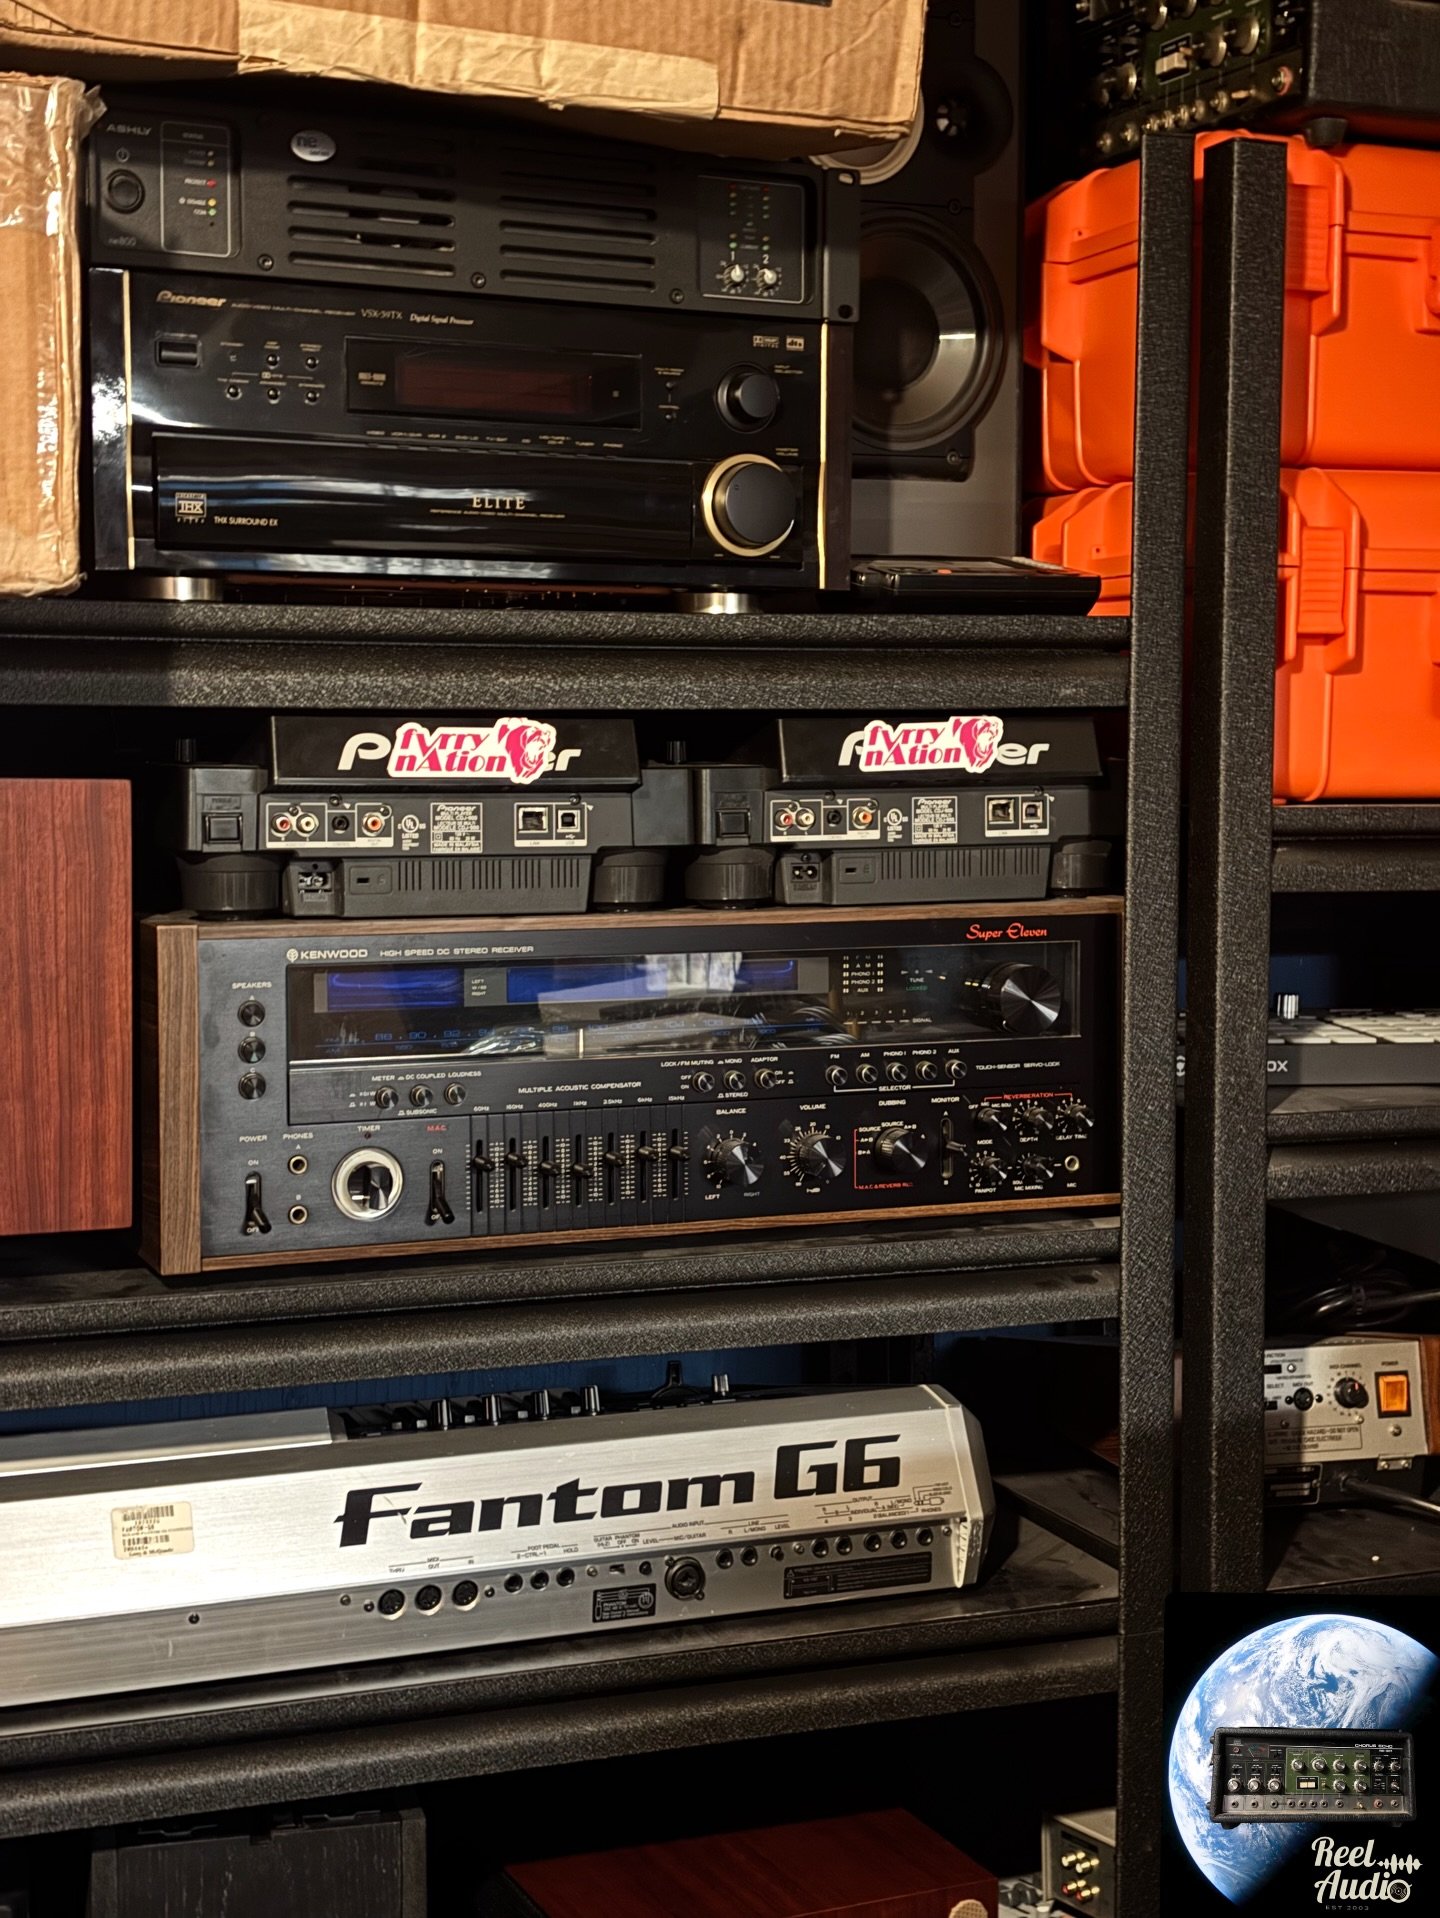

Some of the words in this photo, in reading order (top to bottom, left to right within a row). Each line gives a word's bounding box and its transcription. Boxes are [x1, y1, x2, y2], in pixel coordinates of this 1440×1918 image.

[106, 123, 152, 136] ASHLY
[731, 250, 735, 262] 1
[762, 254, 769, 265] 2
[156, 290, 227, 307] Pioneer
[409, 313, 430, 323] Digital
[431, 315, 448, 324] Signal
[178, 500, 204, 514] THX
[472, 496, 525, 509] ELITE
[214, 516, 227, 524] THX
[229, 517, 267, 526] SURROUND
[269, 518, 278, 526] EX
[436, 804, 477, 812] Pioneer
[966, 923, 1003, 941] Super
[1006, 922, 1047, 939] Eleven
[300, 949, 368, 959] KENWOOD
[453, 947, 488, 955] STEREO
[232, 981, 272, 989] SPEAKERS
[374, 1033, 393, 1041] 88
[409, 1031, 427, 1040] 90
[443, 1029, 461, 1038] 92
[518, 1086, 553, 1094] MULTIPLE
[591, 1082, 642, 1090] COMPENSATOR
[878, 1084, 911, 1092] SELECTOR
[239, 1135, 267, 1143] POWER
[283, 1132, 313, 1140] PHONES
[333, 1471, 755, 1548] Fantom
[773, 1434, 901, 1499] G6
[593, 1535, 612, 1543] GUITAR
